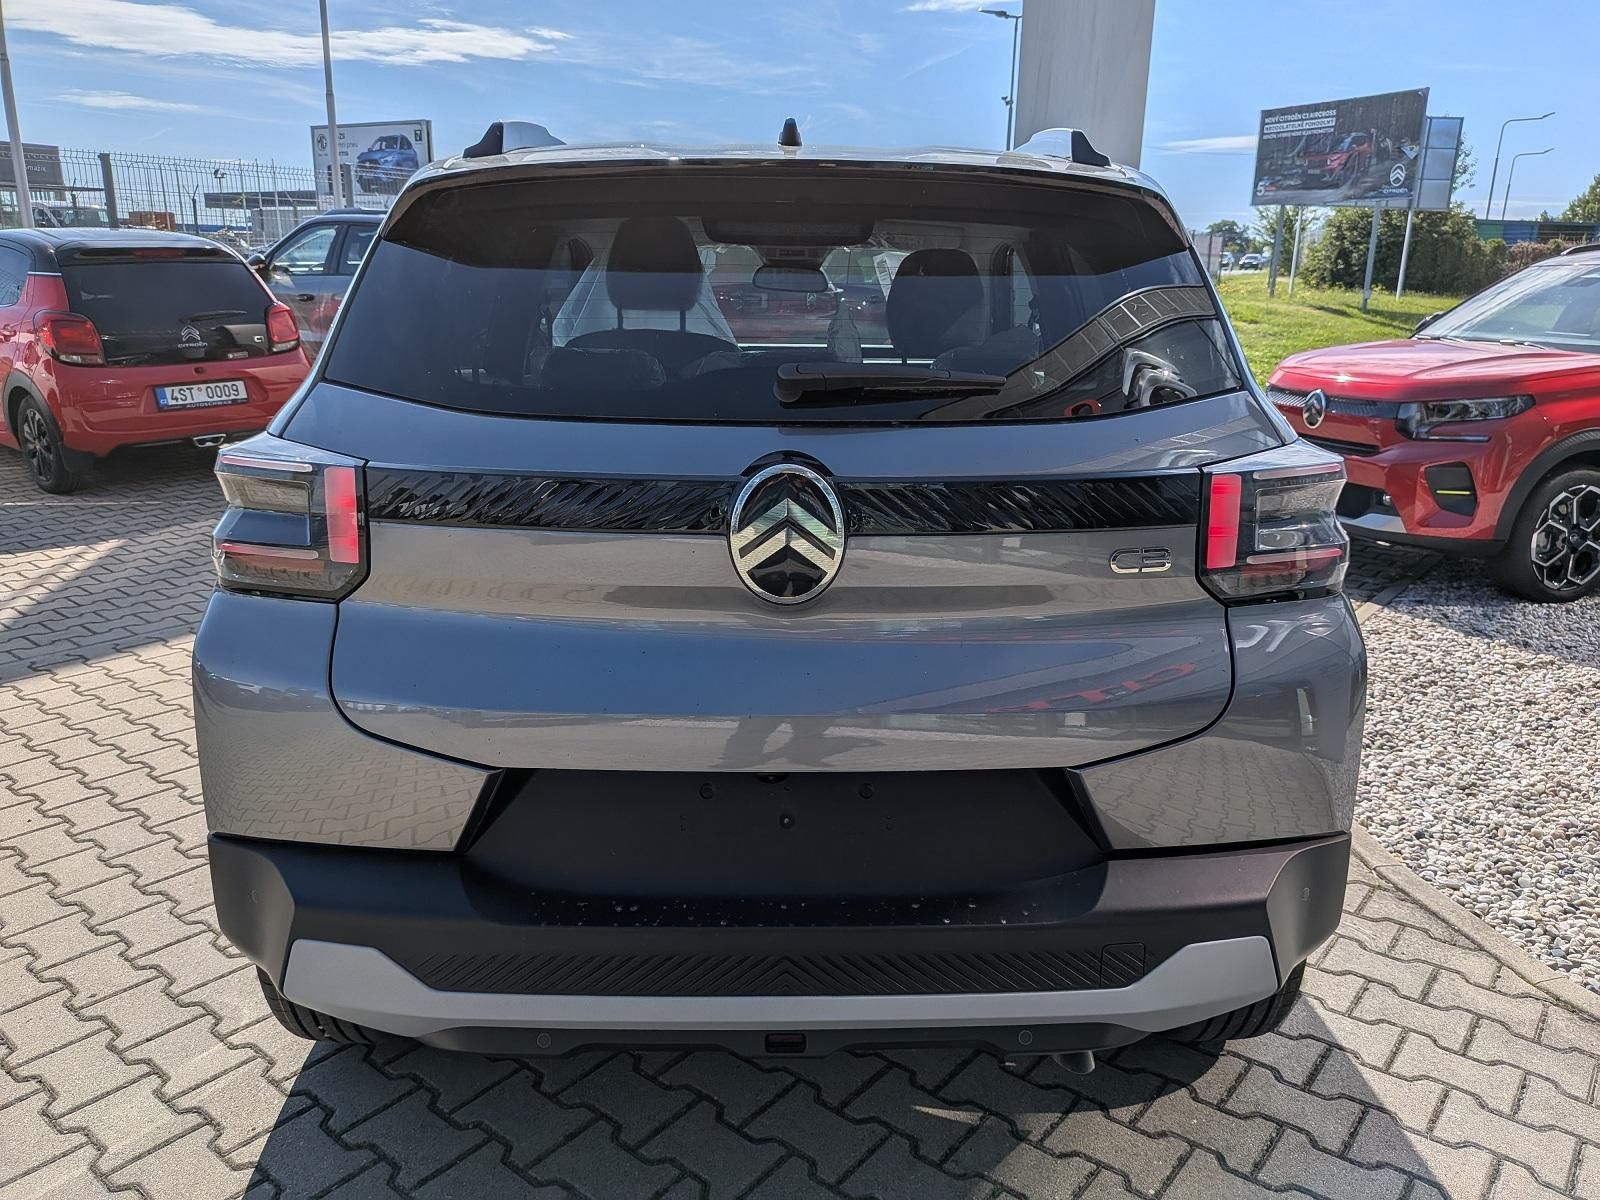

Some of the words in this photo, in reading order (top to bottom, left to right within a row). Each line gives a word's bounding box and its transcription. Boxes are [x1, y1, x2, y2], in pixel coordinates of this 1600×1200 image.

[1279, 112, 1301, 122] CITROËN
[1310, 109, 1337, 119] AIRCROSS
[1256, 182, 1264, 196] 5
[170, 387, 195, 403] 4ST
[206, 383, 240, 399] 0009
[1110, 547, 1172, 574] C3
